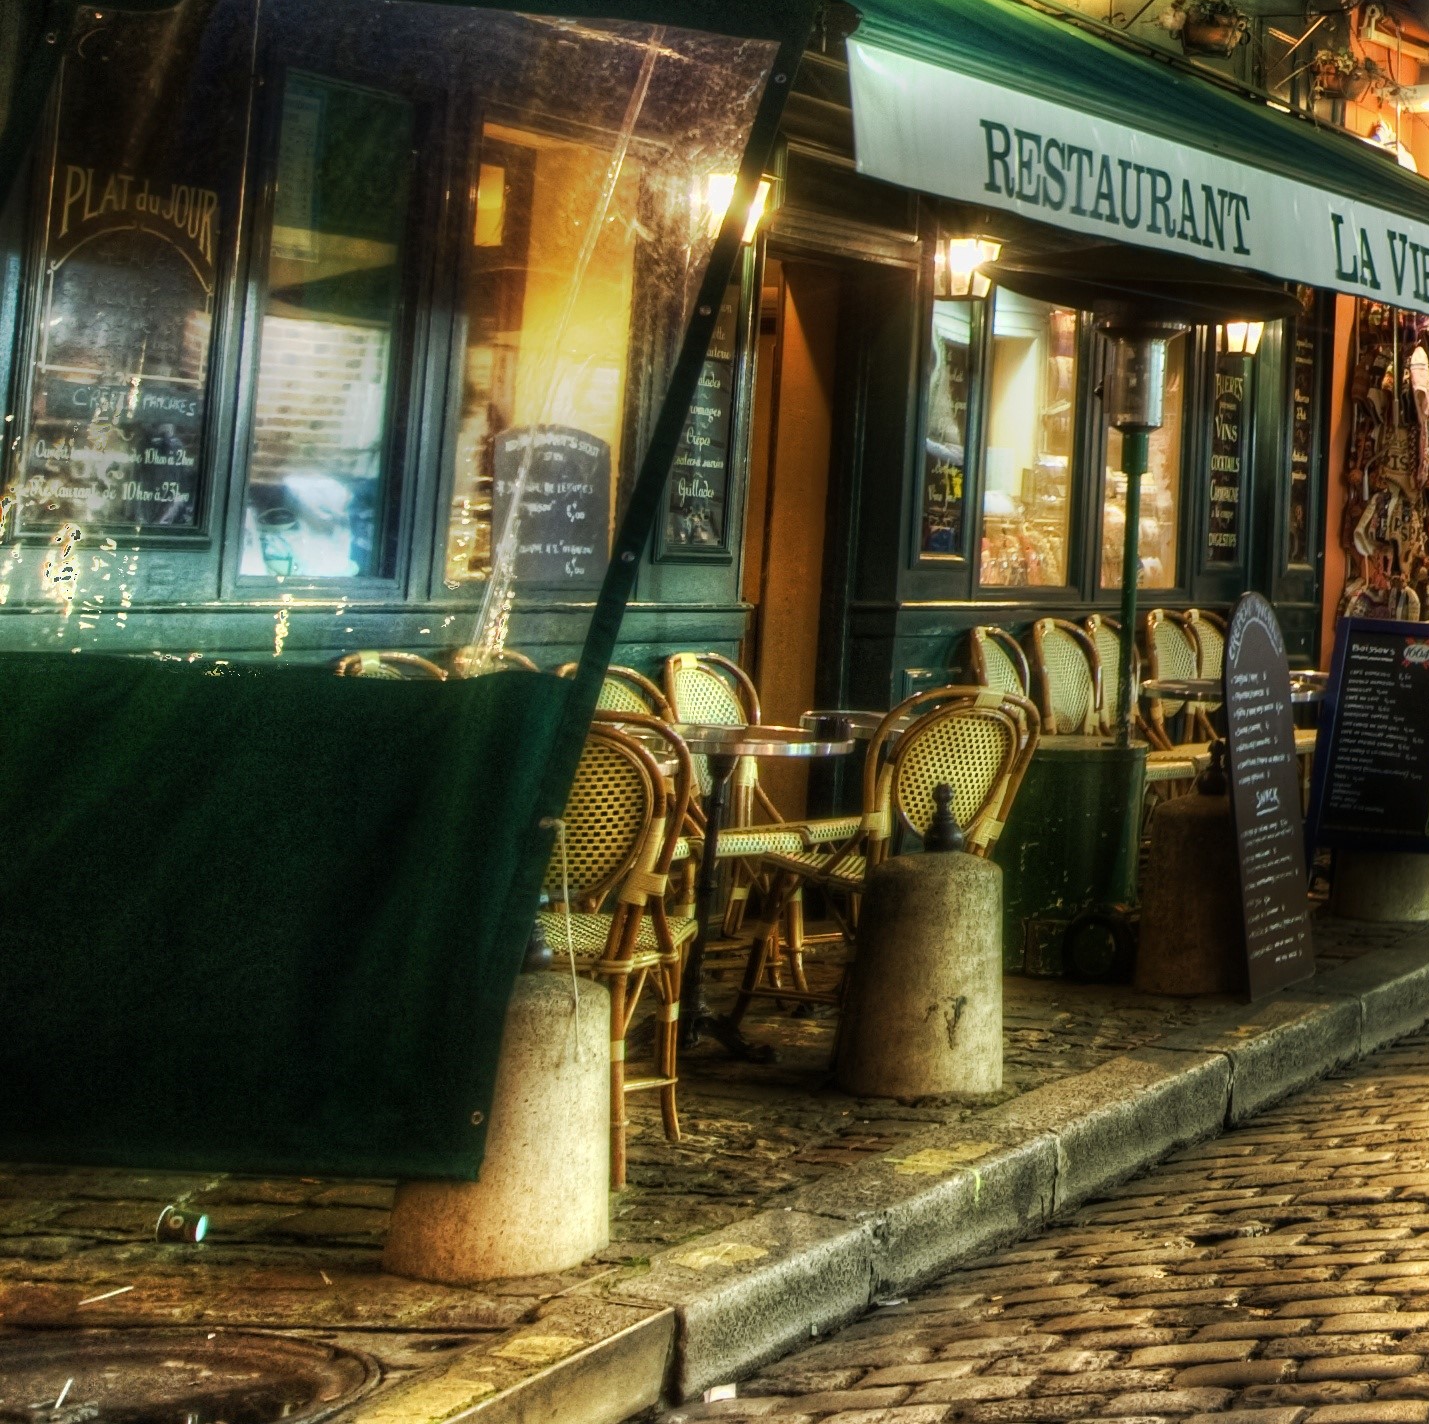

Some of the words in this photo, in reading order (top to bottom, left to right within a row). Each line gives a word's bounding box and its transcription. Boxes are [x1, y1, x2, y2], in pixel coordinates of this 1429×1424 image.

[58, 165, 134, 239] PLAT
[136, 179, 160, 214] du
[162, 184, 217, 266] JOUR
[980, 119, 1251, 257] RESTAURANT
[1331, 213, 1381, 289] LA
[689, 405, 722, 423] romages
[698, 372, 721, 389] alades
